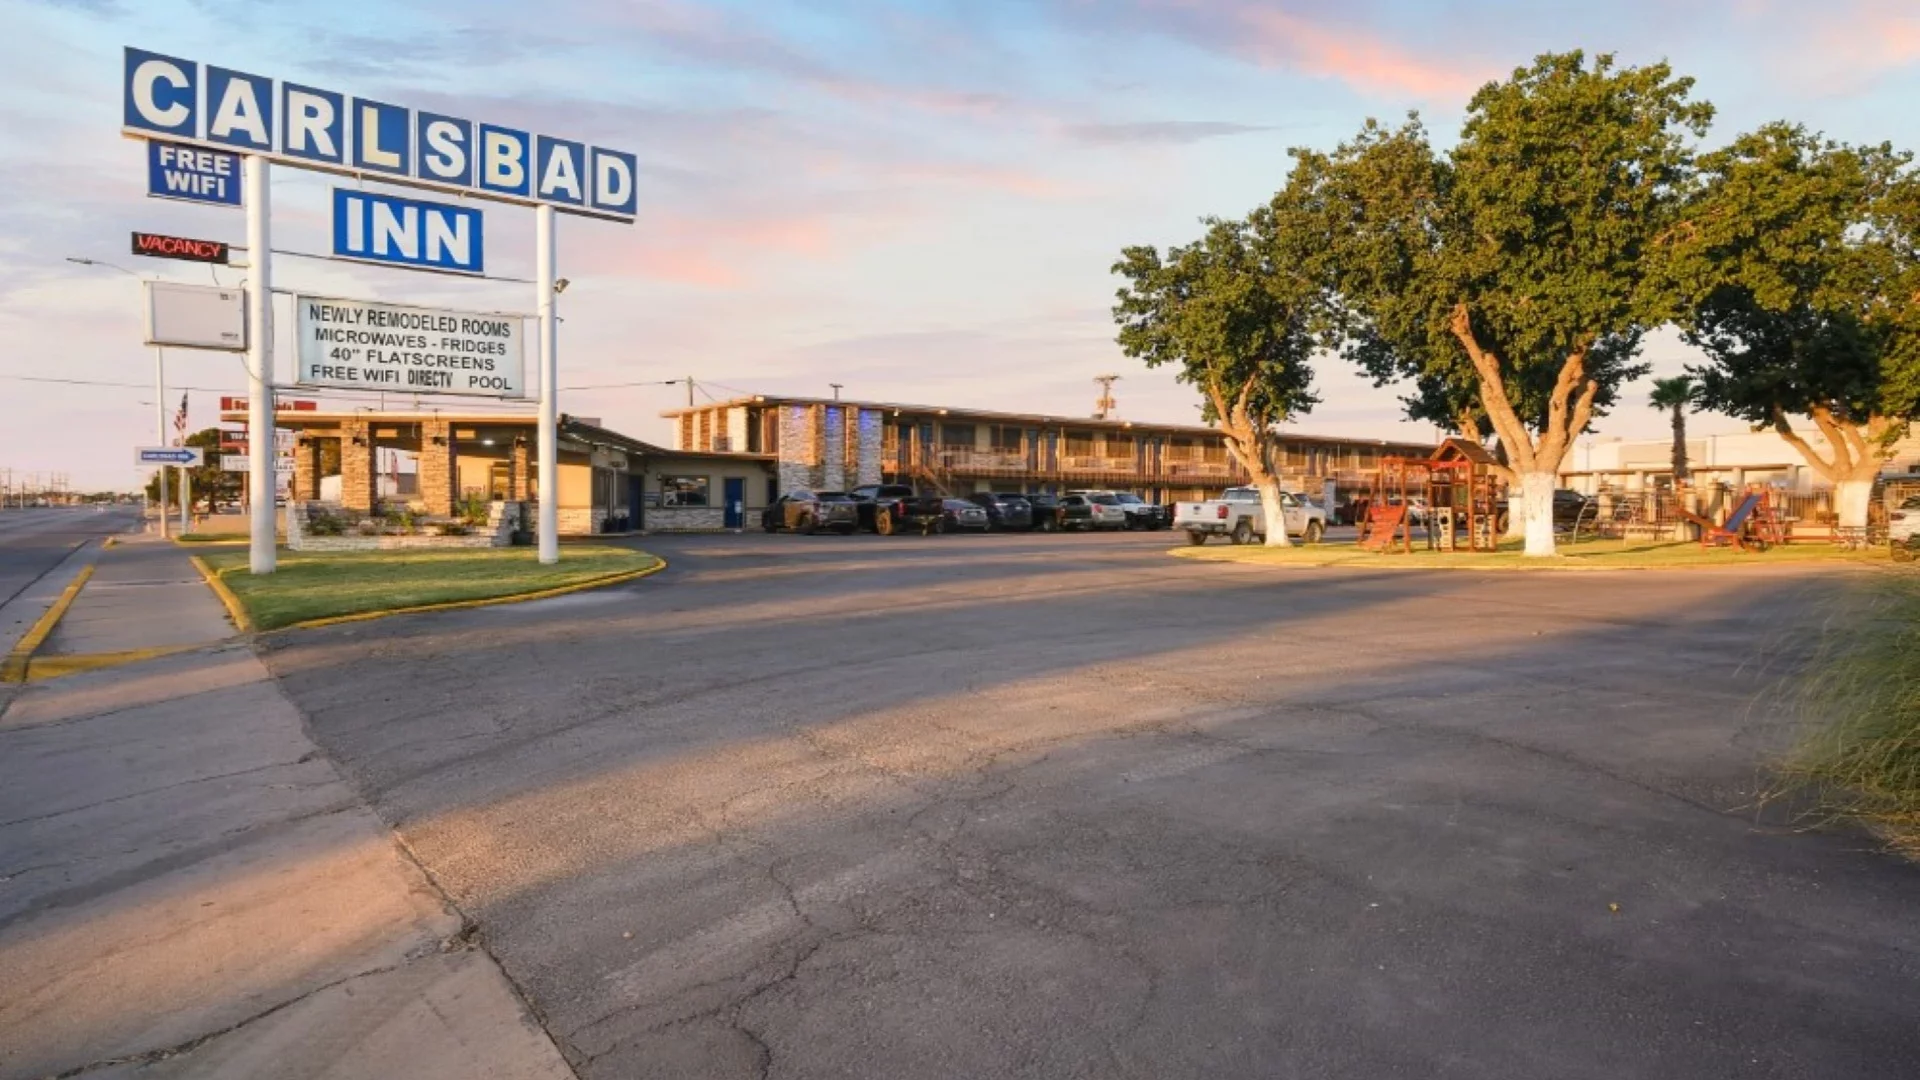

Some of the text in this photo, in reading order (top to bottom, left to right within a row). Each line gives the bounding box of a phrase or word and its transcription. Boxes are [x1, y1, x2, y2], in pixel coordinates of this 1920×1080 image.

[132, 59, 632, 206] CARLSBAD
[160, 146, 231, 176] FREE
[164, 170, 225, 198] WIFI
[346, 197, 470, 265] INN
[138, 235, 220, 257] VACANCY
[310, 304, 511, 338] NEWLY REMODELED ROOMS
[315, 328, 427, 349] MICROWAVES
[441, 338, 507, 356] FRIDGES
[366, 349, 495, 371] FLATSCREENS
[311, 364, 513, 390] FREE WIFI DIRECTV POOL
